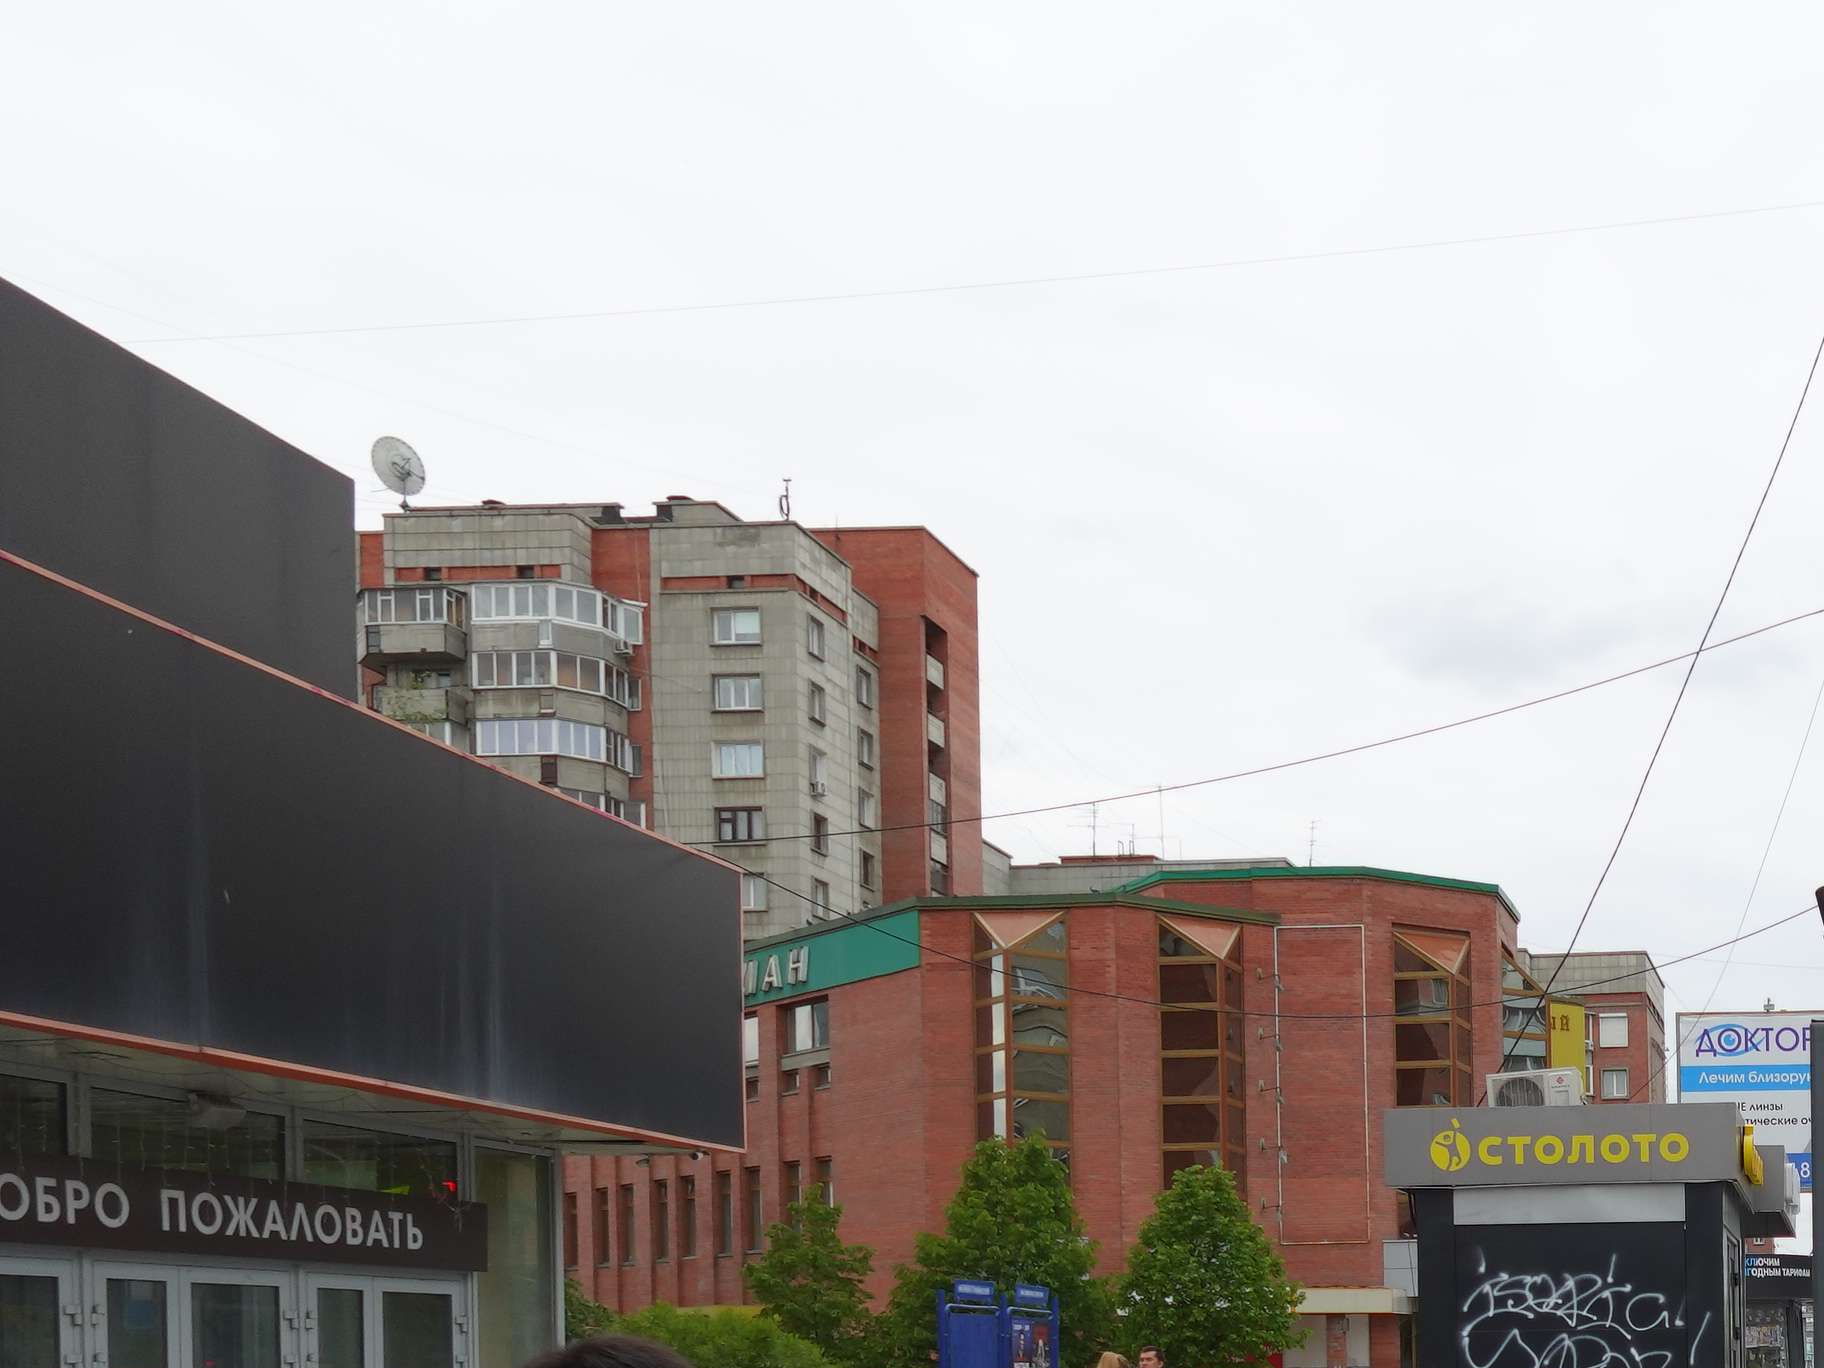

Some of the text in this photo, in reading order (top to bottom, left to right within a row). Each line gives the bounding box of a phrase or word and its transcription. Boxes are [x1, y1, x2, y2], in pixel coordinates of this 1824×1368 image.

[1699, 1072, 1745, 1084] Лечим
[1750, 1103, 1783, 1112] линзы
[1478, 1132, 1690, 1166] СТОЛОТО
[160, 1189, 424, 1250] ПОЖАЛОВАТЬ
